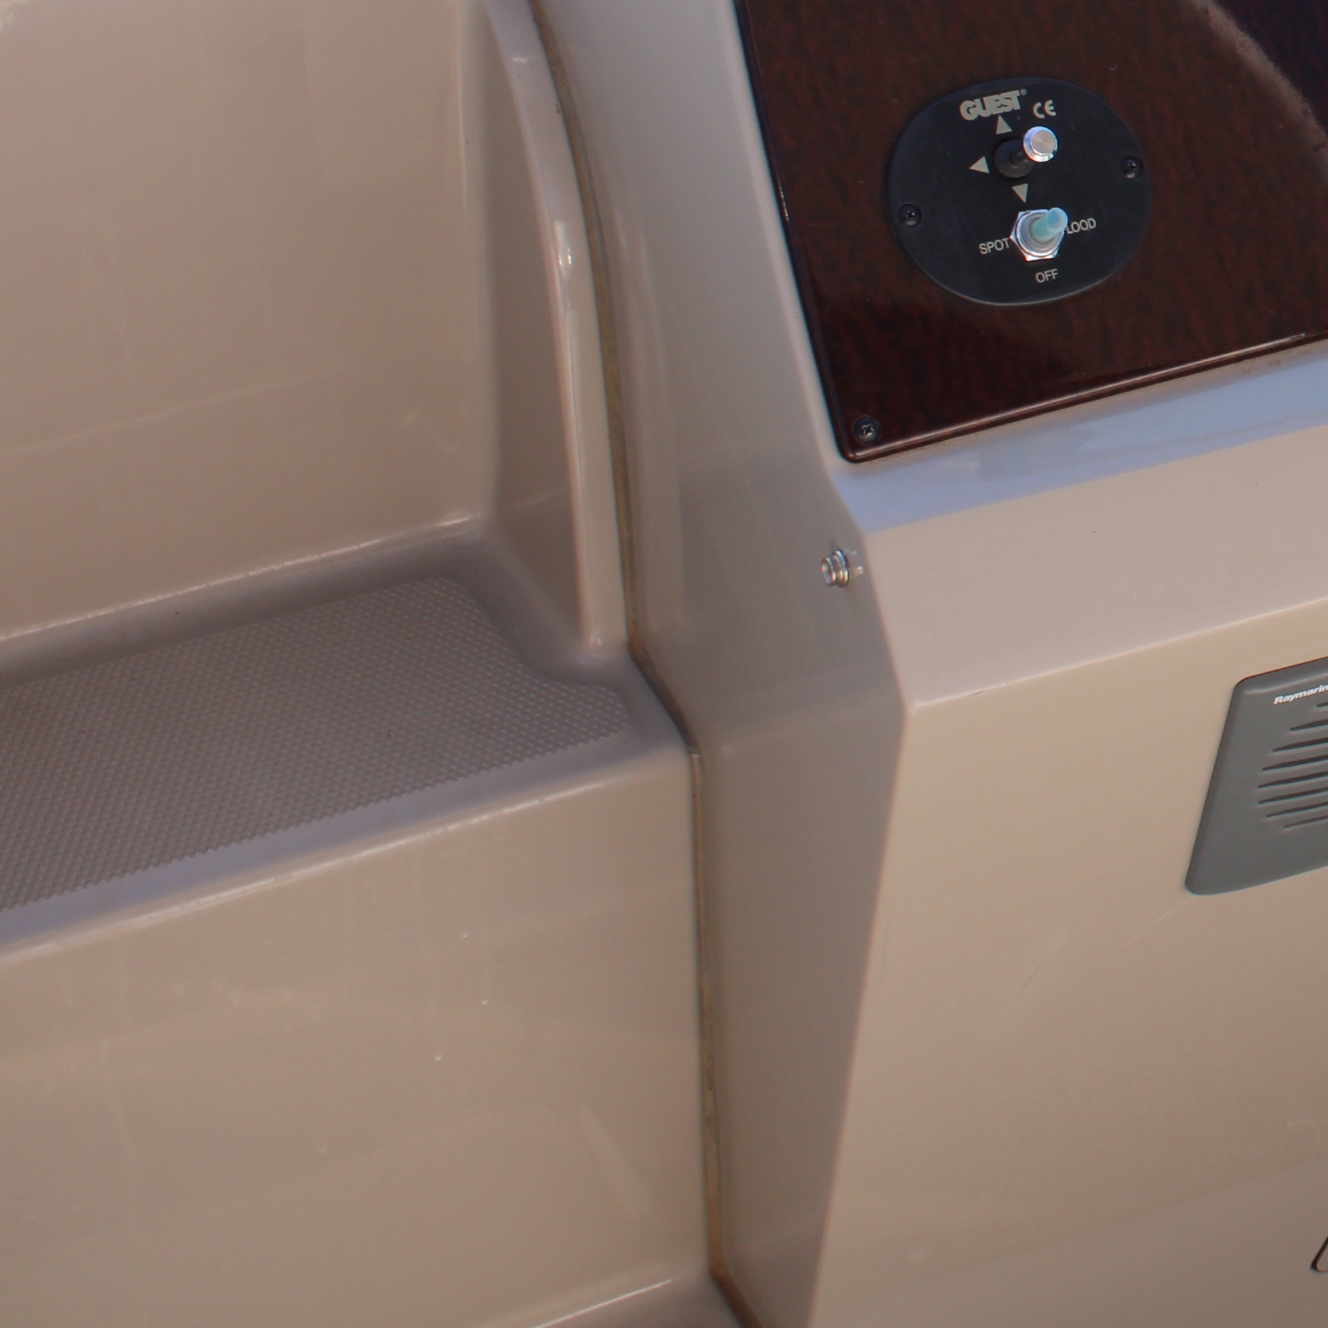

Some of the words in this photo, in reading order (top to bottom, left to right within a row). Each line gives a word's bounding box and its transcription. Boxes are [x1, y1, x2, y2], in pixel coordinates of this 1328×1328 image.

[1063, 217, 1097, 235] LOOD
[979, 237, 1010, 255] SPOT
[1035, 269, 1058, 283] OFF
